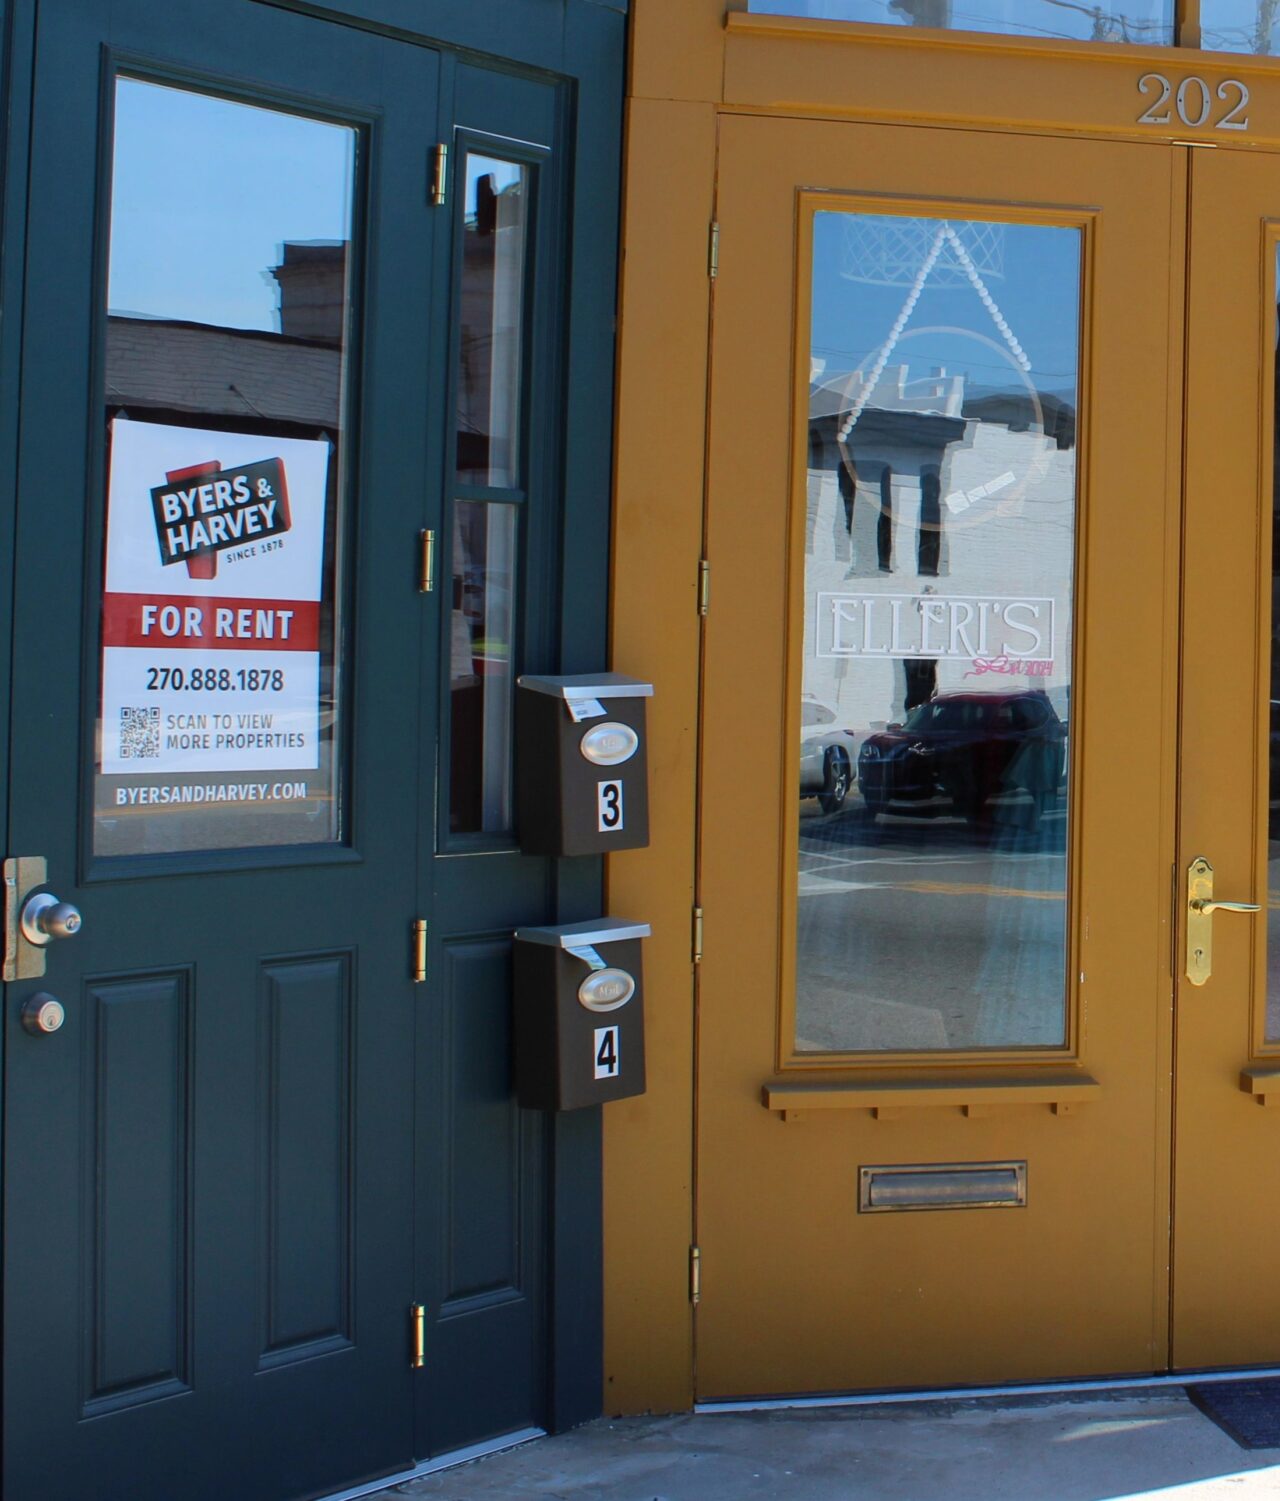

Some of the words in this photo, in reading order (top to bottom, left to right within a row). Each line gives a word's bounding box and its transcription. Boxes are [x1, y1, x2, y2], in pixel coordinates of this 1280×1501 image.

[1137, 73, 1249, 131] 202
[161, 475, 251, 523] BYERS
[257, 478, 274, 498] &
[166, 500, 277, 556] HARVEY
[226, 547, 257, 563] SINCE
[261, 538, 284, 554] 1878
[141, 604, 204, 637] FOR
[214, 608, 294, 640] RENT
[830, 598, 1042, 658] ELLERI'S
[147, 667, 284, 691] 270.888.1878
[166, 714, 208, 730] SCAN
[214, 714, 232, 729] TO
[237, 714, 274, 729] VIEW
[166, 734, 210, 750] MORE
[215, 733, 305, 749] PROPERTIES
[115, 781, 307, 806] BYERSANDHARVEY.COM
[602, 783, 620, 829] 3
[596, 1030, 617, 1074] 4
